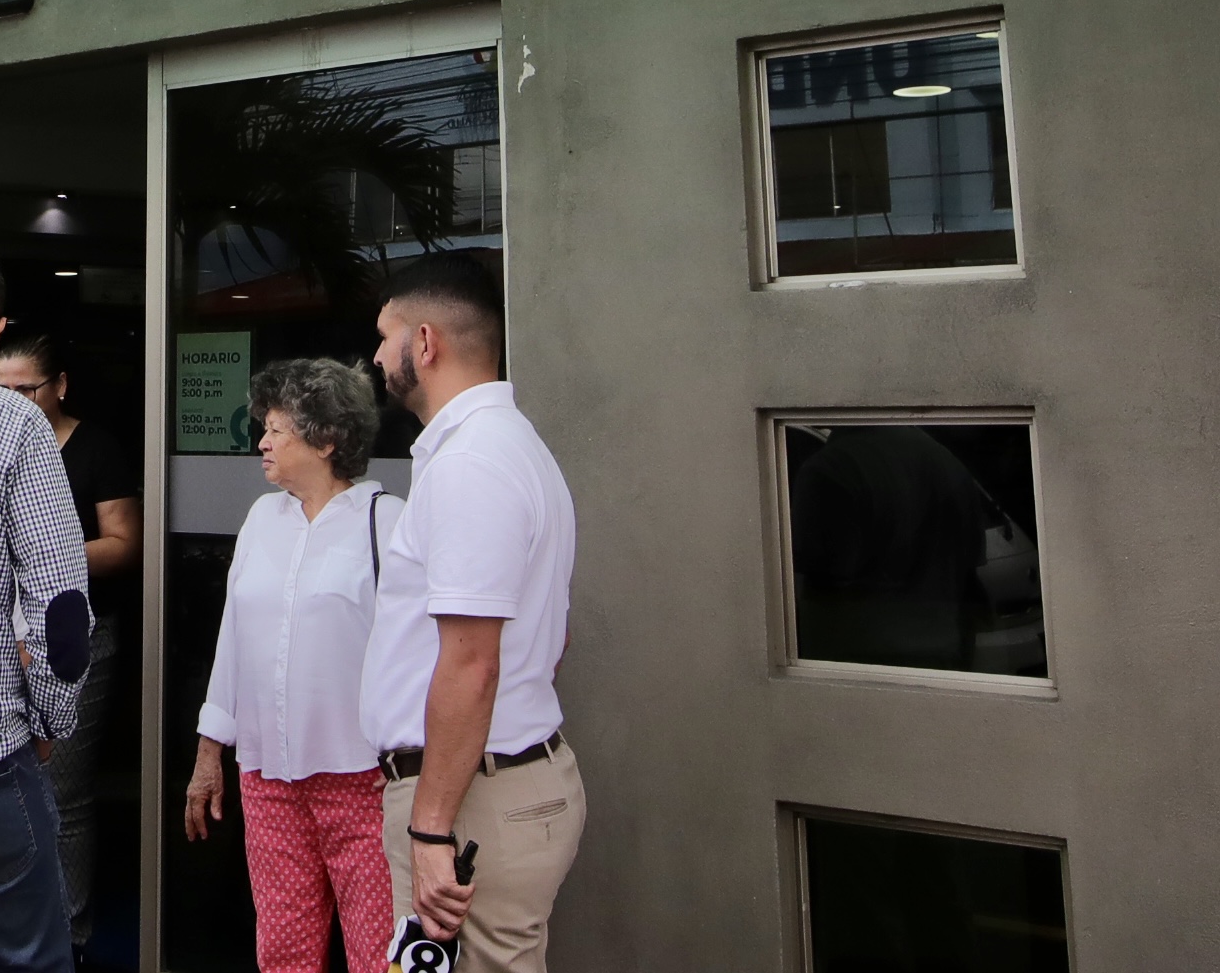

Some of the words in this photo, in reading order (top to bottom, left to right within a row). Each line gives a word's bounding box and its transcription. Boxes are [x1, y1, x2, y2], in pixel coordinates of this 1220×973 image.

[181, 352, 241, 365] HORARIO
[181, 378, 202, 387] 9:00
[204, 379, 223, 387] a.m
[181, 388, 202, 397] 5:00
[204, 389, 223, 399] p.m
[181, 414, 202, 423] 9:00
[204, 415, 223, 424] a.m
[181, 425, 206, 434] 12:00
[208, 426, 227, 436] p.m
[409, 942, 444, 973] 8
